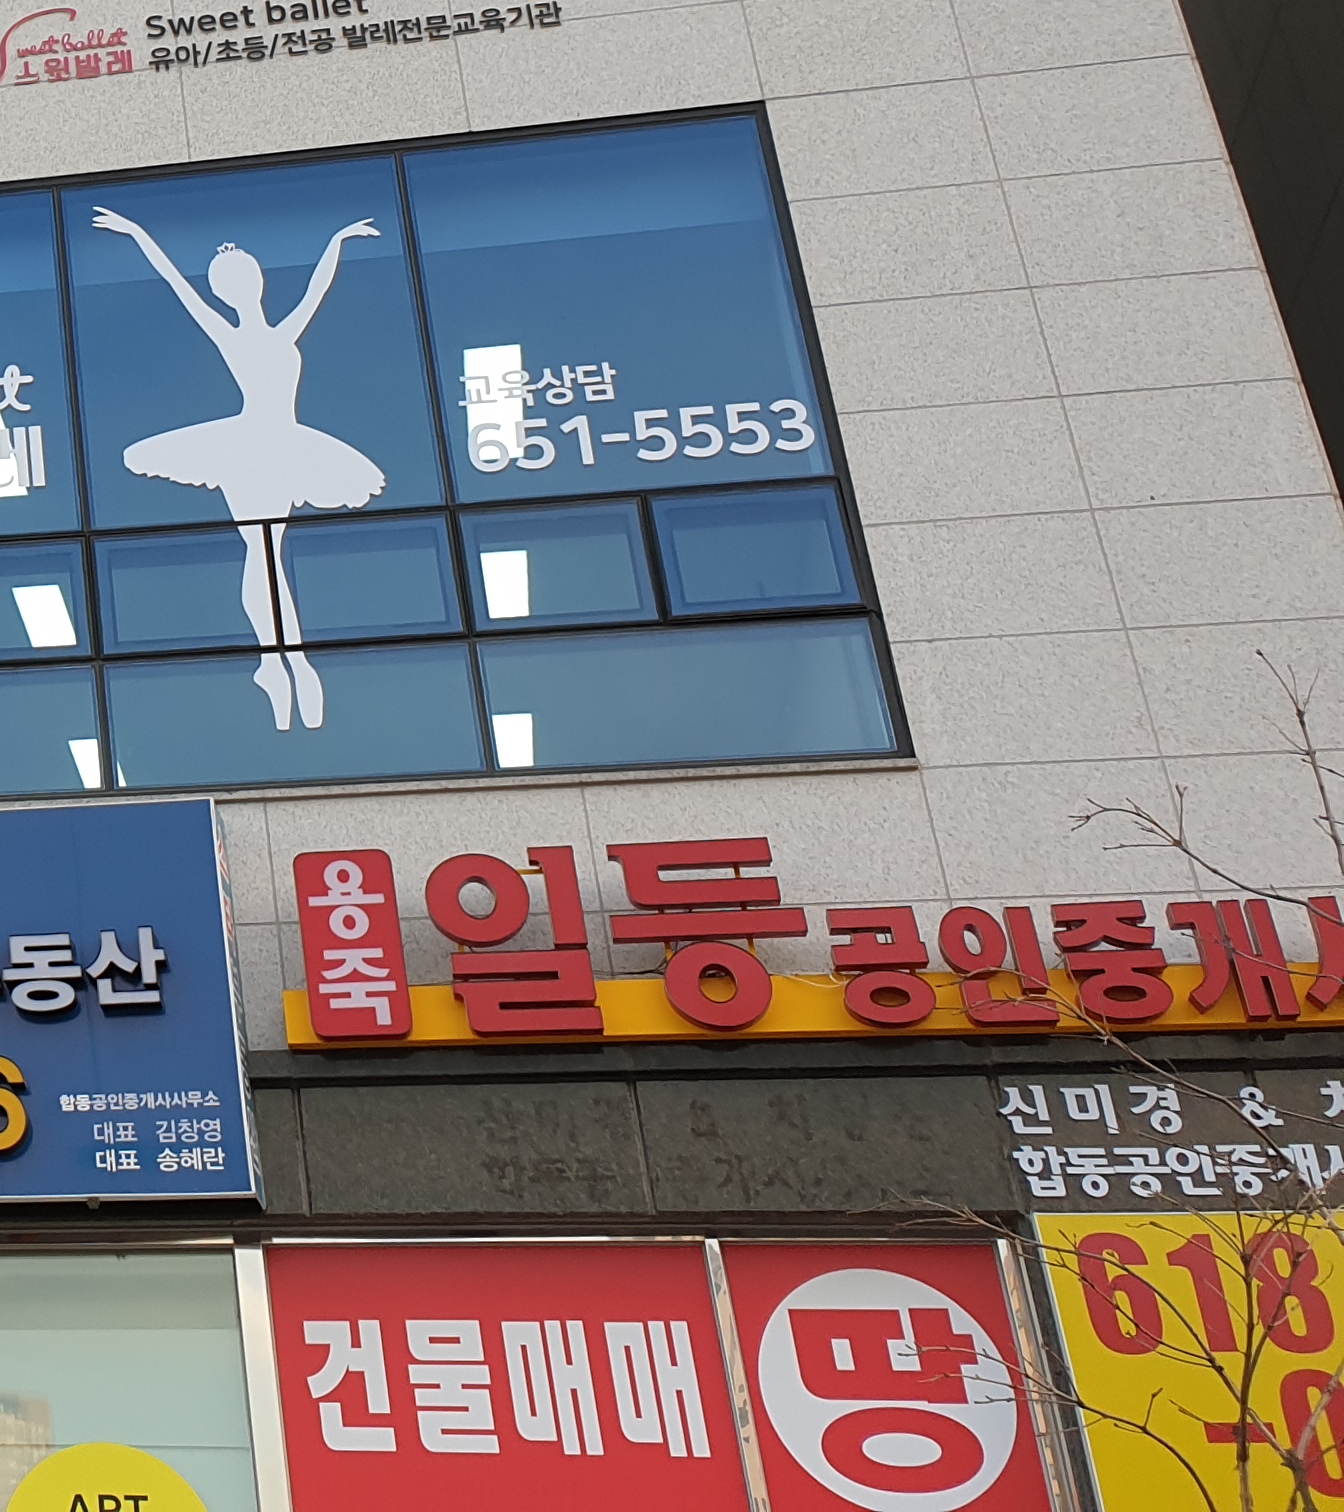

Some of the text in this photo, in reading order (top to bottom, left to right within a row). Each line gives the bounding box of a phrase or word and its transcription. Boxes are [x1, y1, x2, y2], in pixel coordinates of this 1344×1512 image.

[145, 2, 256, 39] Sweet
[148, 0, 564, 73] 유아/초등/전공 발레전문교육기관
[14, 49, 134, 86] 스윗발레
[458, 361, 617, 408] 교육상담
[466, 399, 816, 473] 651-5553
[307, 859, 399, 1028] 용죽
[424, 835, 809, 1038] 일등
[59, 1090, 221, 1112] 합동공인중개사사무소
[999, 1083, 1184, 1135] 신미경
[1239, 1085, 1285, 1128] &
[93, 1117, 222, 1144] 대표 김창영
[95, 1146, 226, 1172] 대표 송혜란
[1077, 1231, 1336, 1356] 618
[303, 1319, 712, 1459] 건물매매
[788, 1307, 985, 1495] 땅
